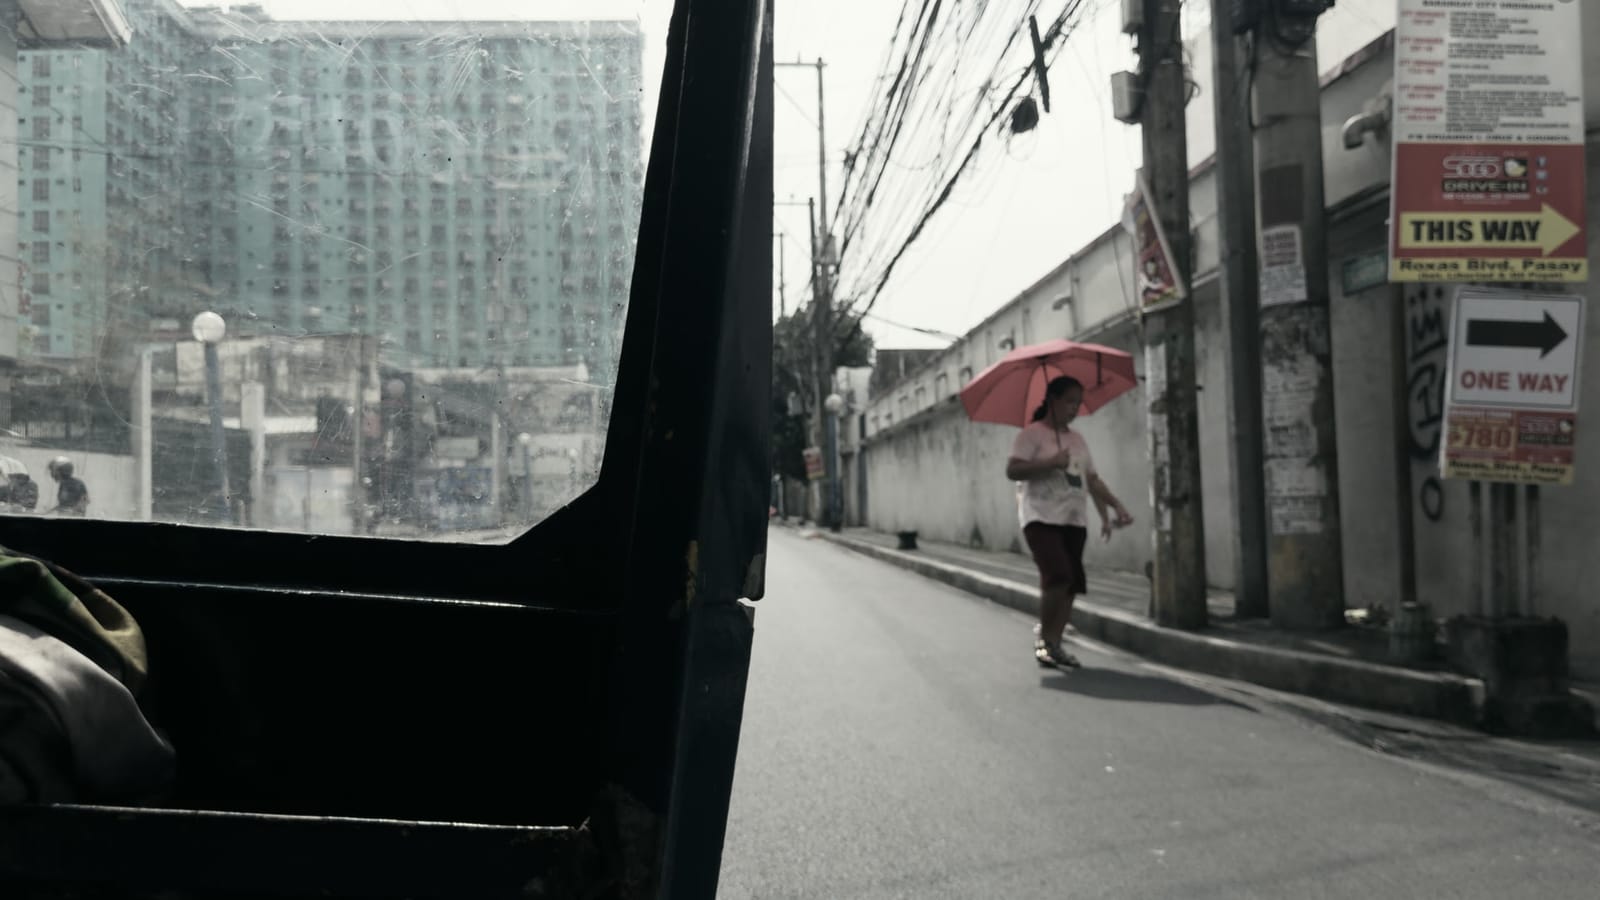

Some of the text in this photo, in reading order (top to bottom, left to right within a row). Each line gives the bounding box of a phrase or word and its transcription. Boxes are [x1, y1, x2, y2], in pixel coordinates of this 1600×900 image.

[1443, 181, 1528, 193] DRIVE-IN
[1410, 219, 1542, 242] THIS WAY
[1399, 258, 1460, 272] Roxas
[1522, 258, 1582, 273] Pasay
[1460, 370, 1568, 394] ONE WAY
